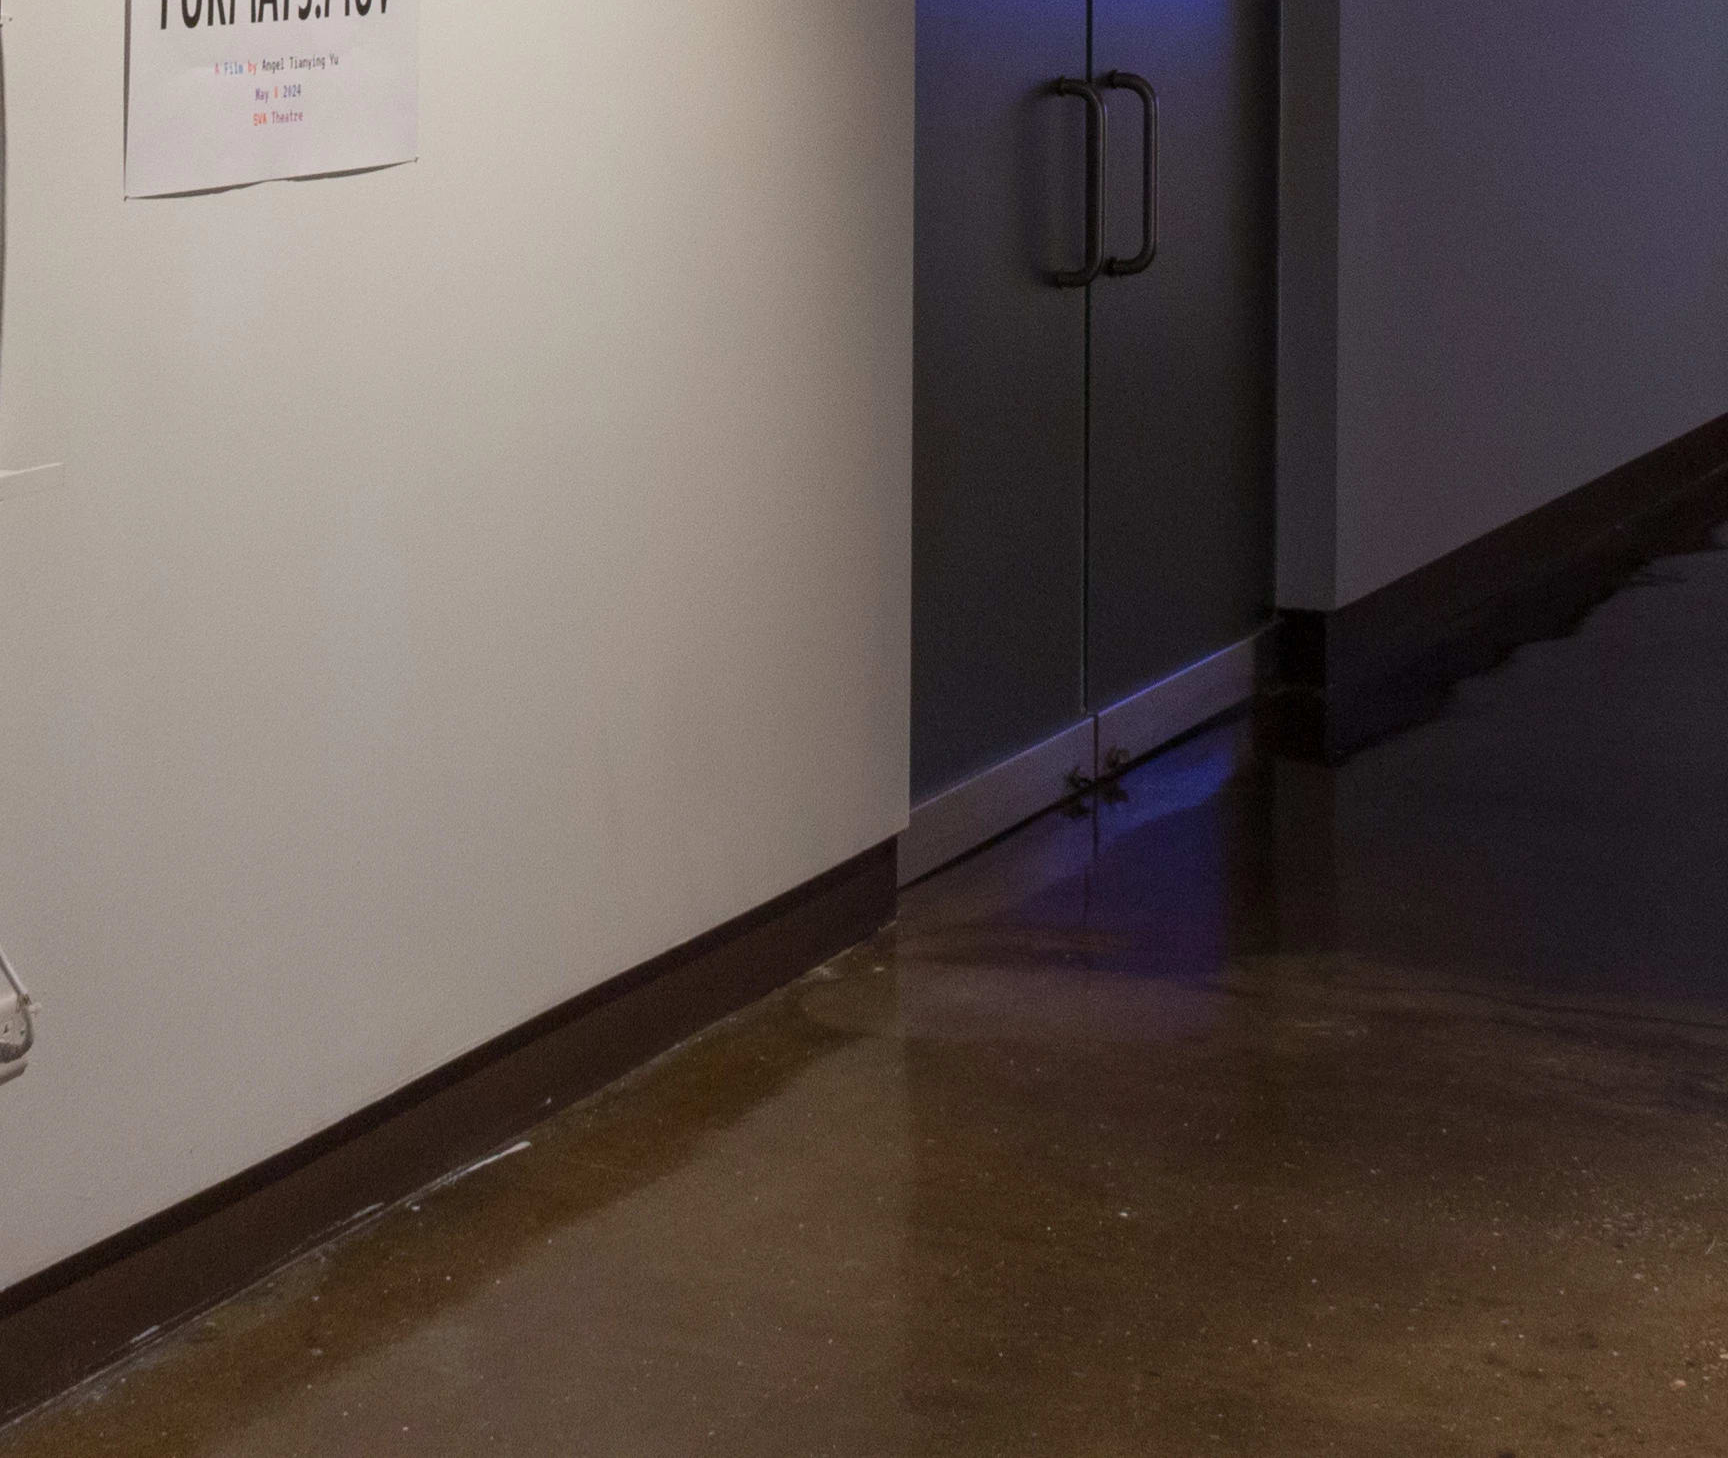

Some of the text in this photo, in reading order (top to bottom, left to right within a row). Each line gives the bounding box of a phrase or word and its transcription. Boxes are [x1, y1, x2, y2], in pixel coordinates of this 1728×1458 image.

[224, 61, 244, 76] Film
[247, 59, 257, 76] by
[262, 58, 285, 74] Angel
[330, 53, 339, 65] Yu
[255, 87, 269, 103] May
[272, 110, 304, 124] Theatre
